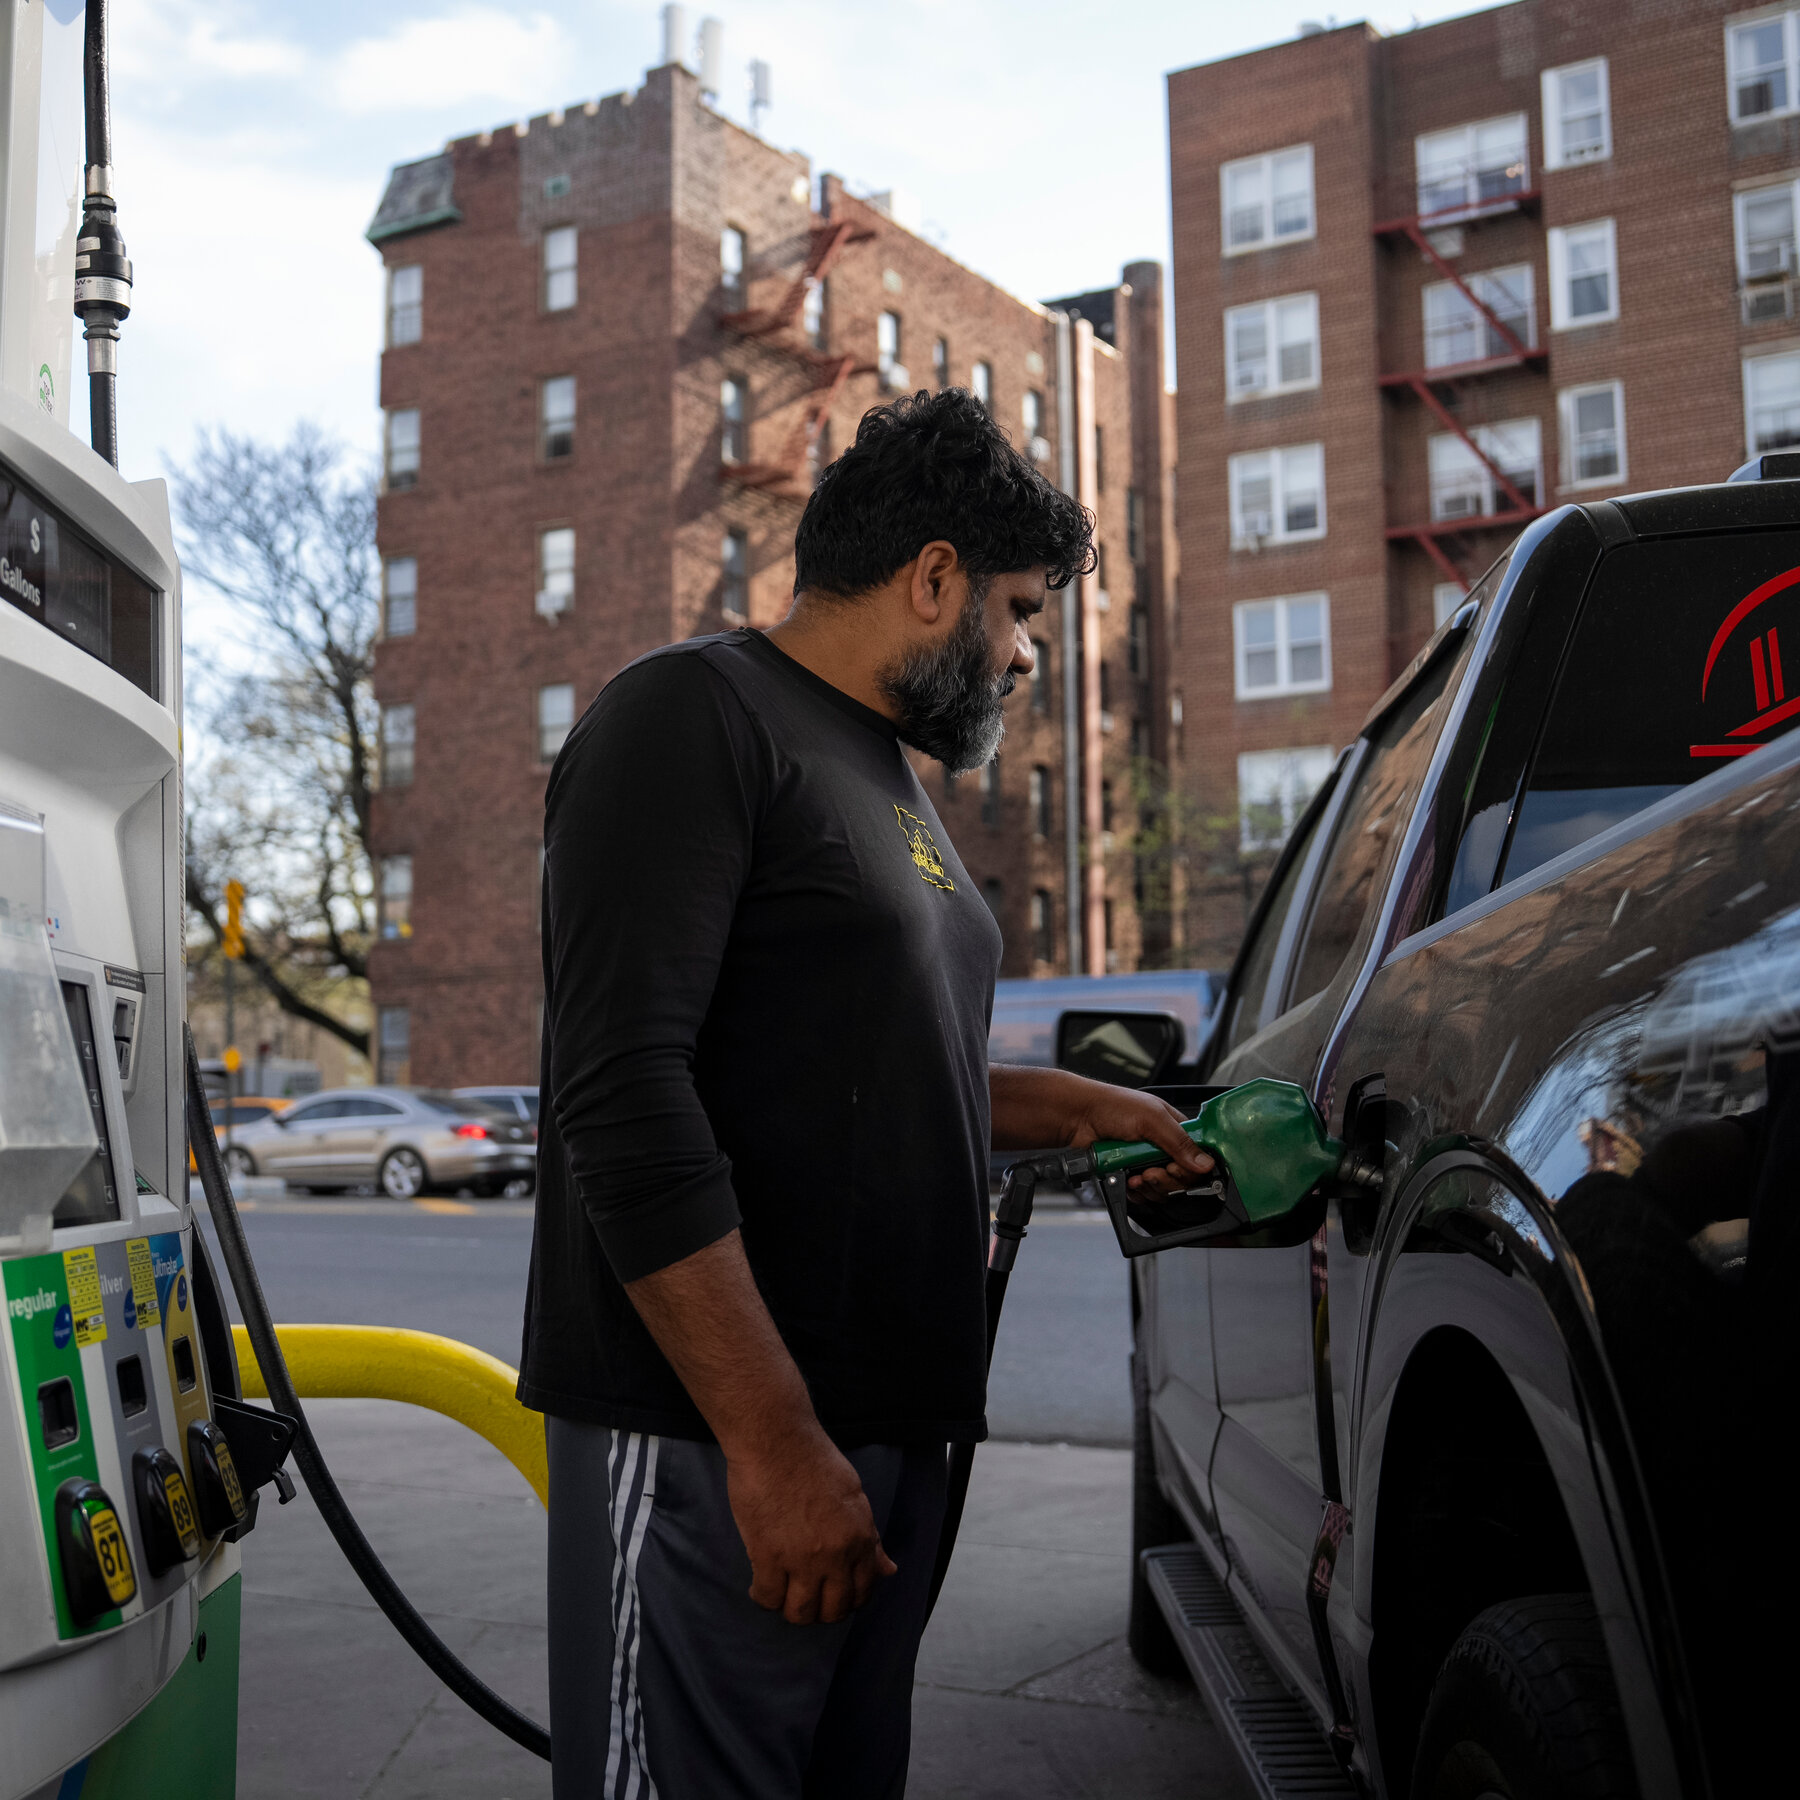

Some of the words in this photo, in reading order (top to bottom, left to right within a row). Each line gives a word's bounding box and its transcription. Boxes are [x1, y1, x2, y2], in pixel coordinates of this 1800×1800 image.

[0, 557, 41, 607] Gallons
[100, 1274, 123, 1295] ilver
[153, 1256, 177, 1278] ultimate
[9, 1287, 57, 1320] regular
[172, 1495, 191, 1532] 89
[99, 1532, 124, 1577] 87
